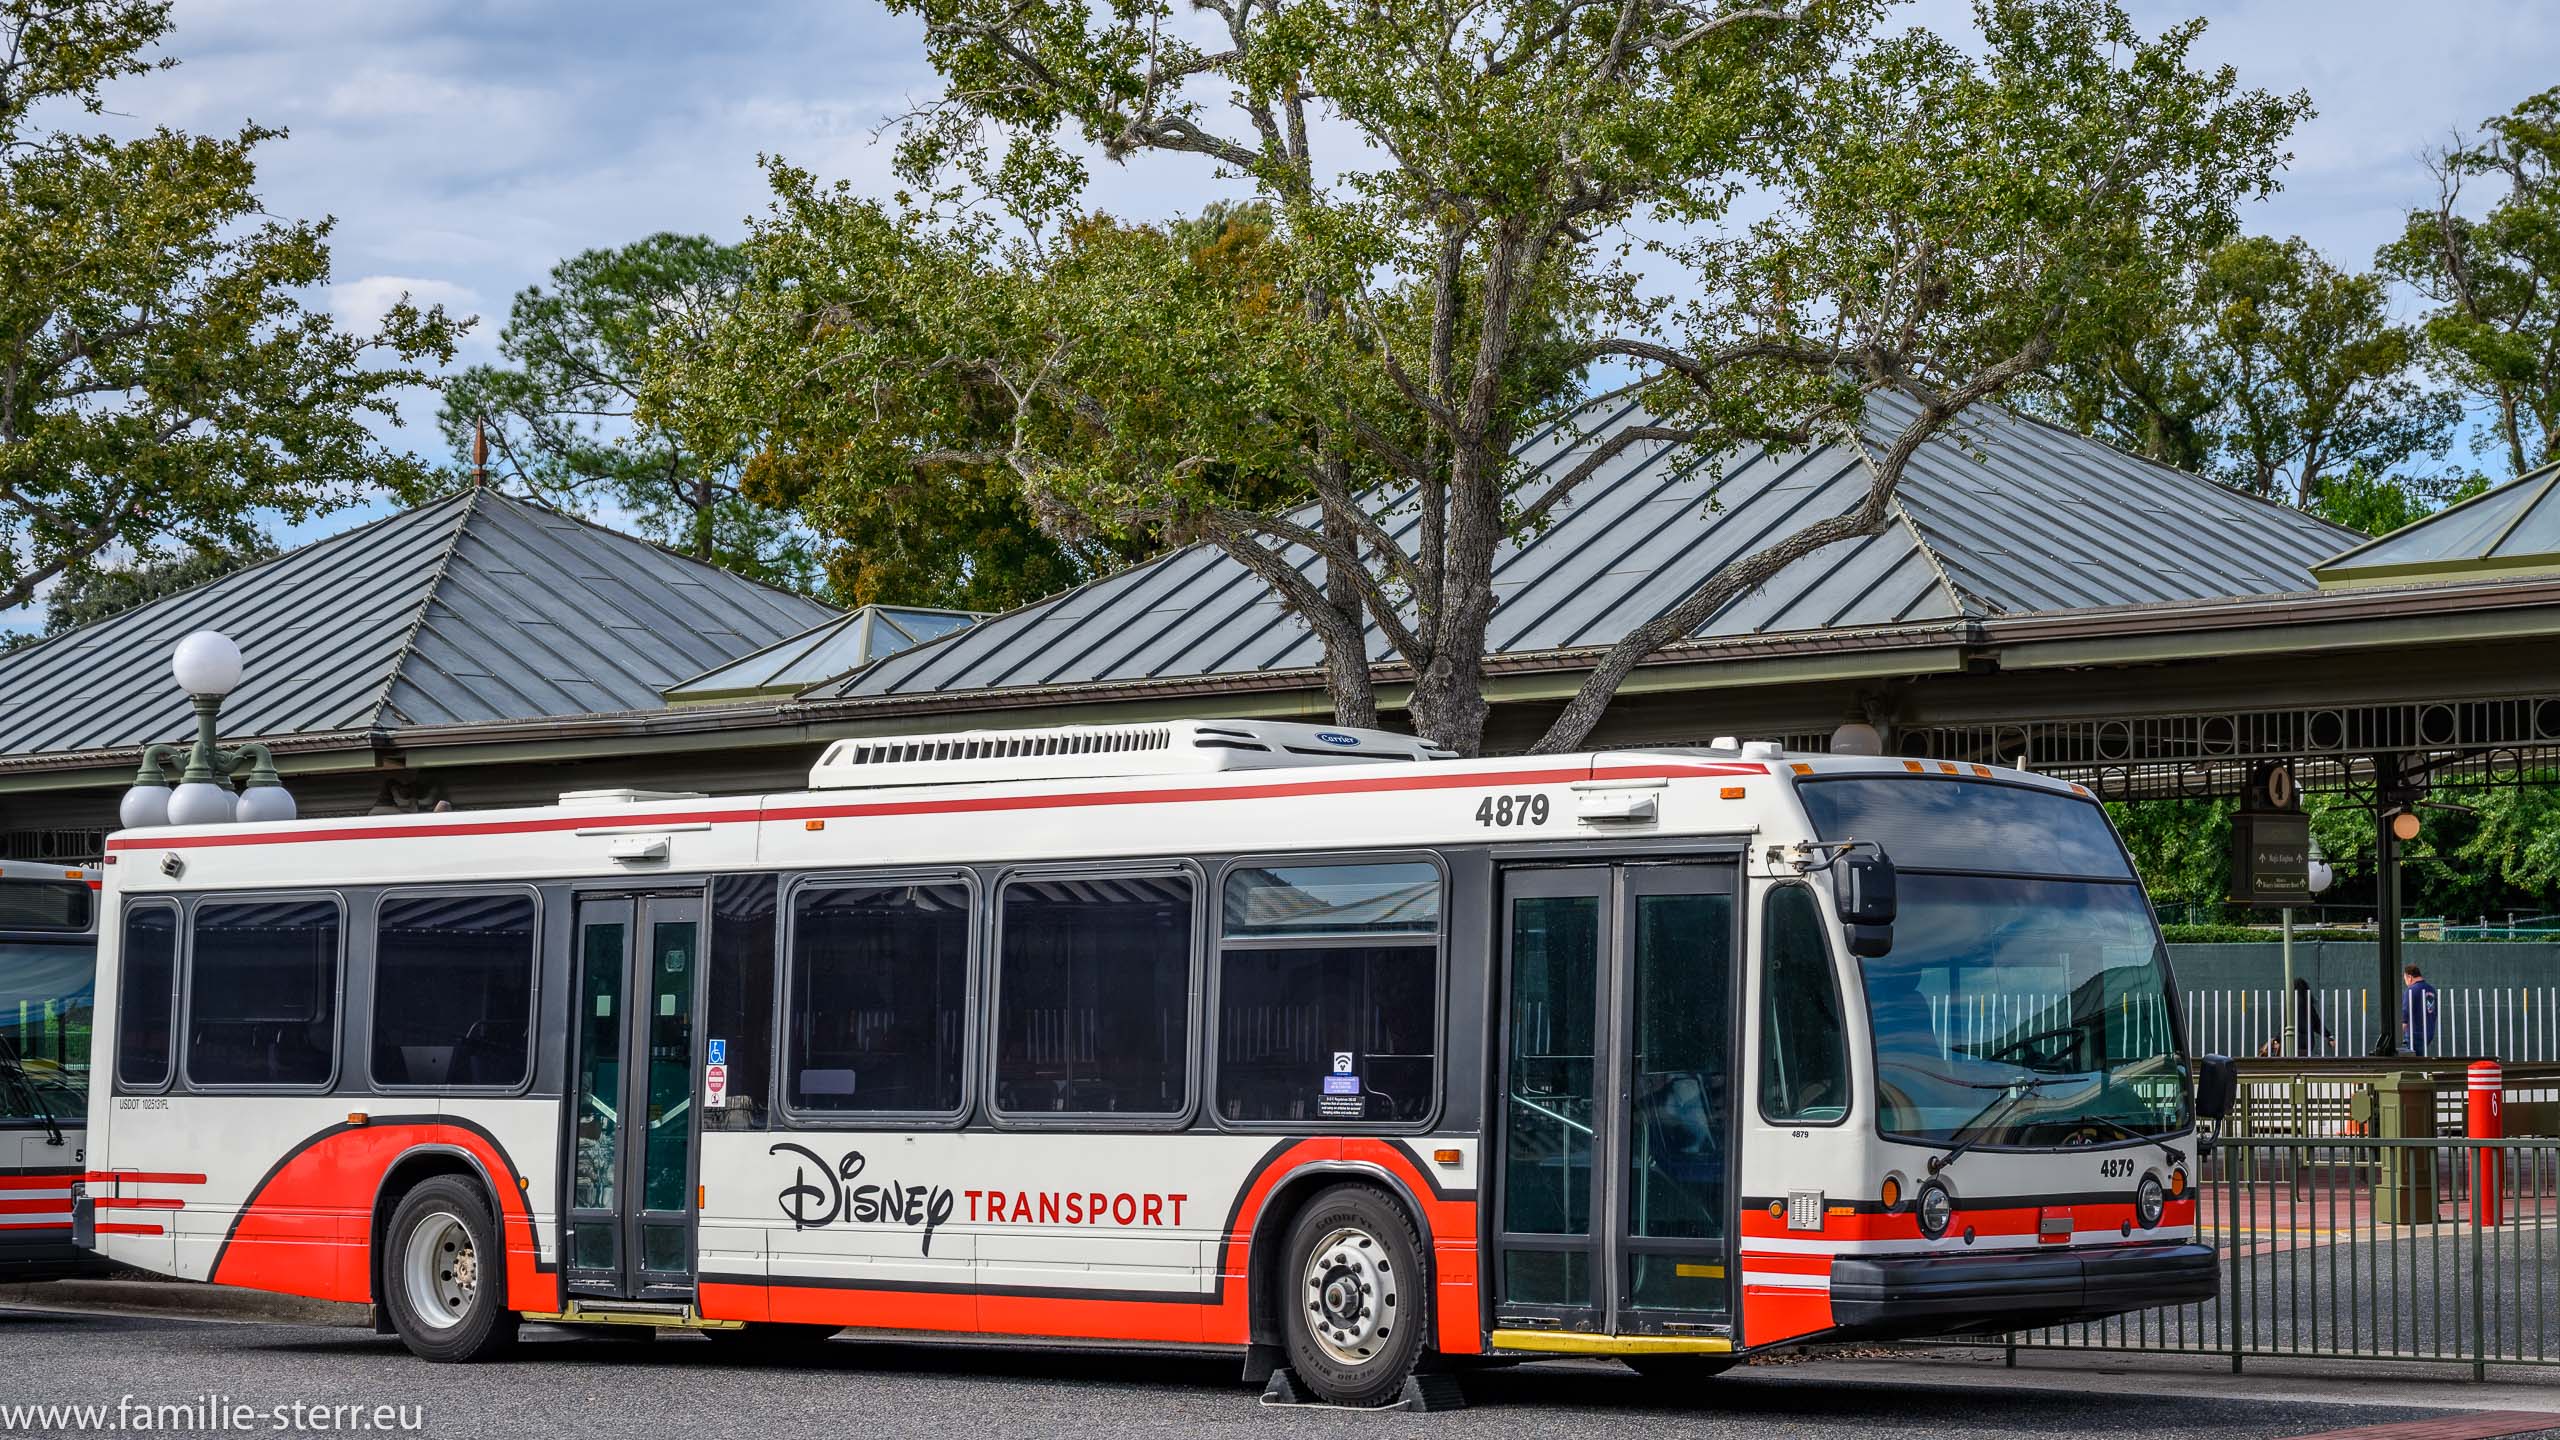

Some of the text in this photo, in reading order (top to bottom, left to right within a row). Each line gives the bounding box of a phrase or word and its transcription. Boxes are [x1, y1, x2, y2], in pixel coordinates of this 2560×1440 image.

[1321, 735, 1354, 743] Carrier
[2275, 772, 2283, 800] 4
[1475, 793, 1550, 827] 4879
[119, 1099, 139, 1110] USDOT
[2491, 1092, 2498, 1117] 6
[1791, 1130, 1809, 1139] 4879
[75, 1149, 86, 1162] 5
[2100, 1158, 2135, 1178] 4879
[964, 1190, 1188, 1226] TRANSPORT
